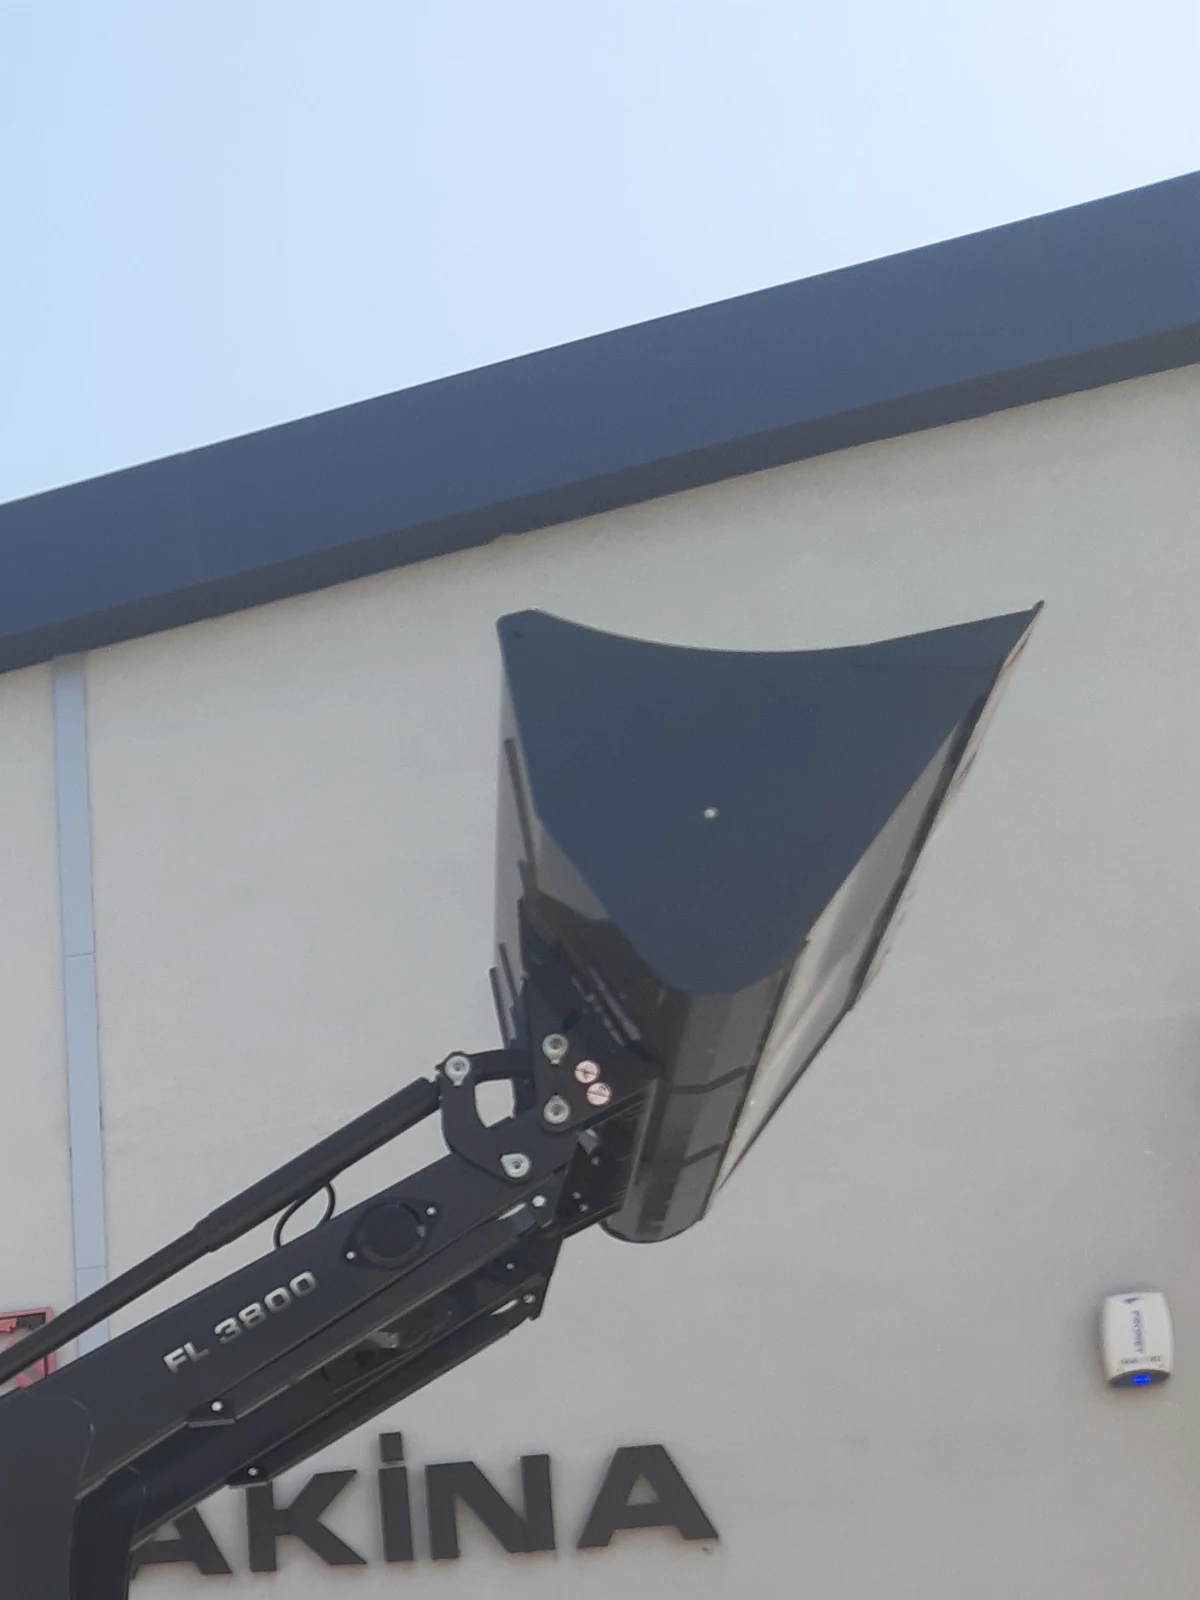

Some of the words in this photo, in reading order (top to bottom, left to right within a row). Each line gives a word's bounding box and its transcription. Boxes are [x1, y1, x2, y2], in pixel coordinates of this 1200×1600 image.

[163, 1341, 209, 1374] FL
[214, 1271, 317, 1344] 3800
[129, 1432, 719, 1580] AKİNA
